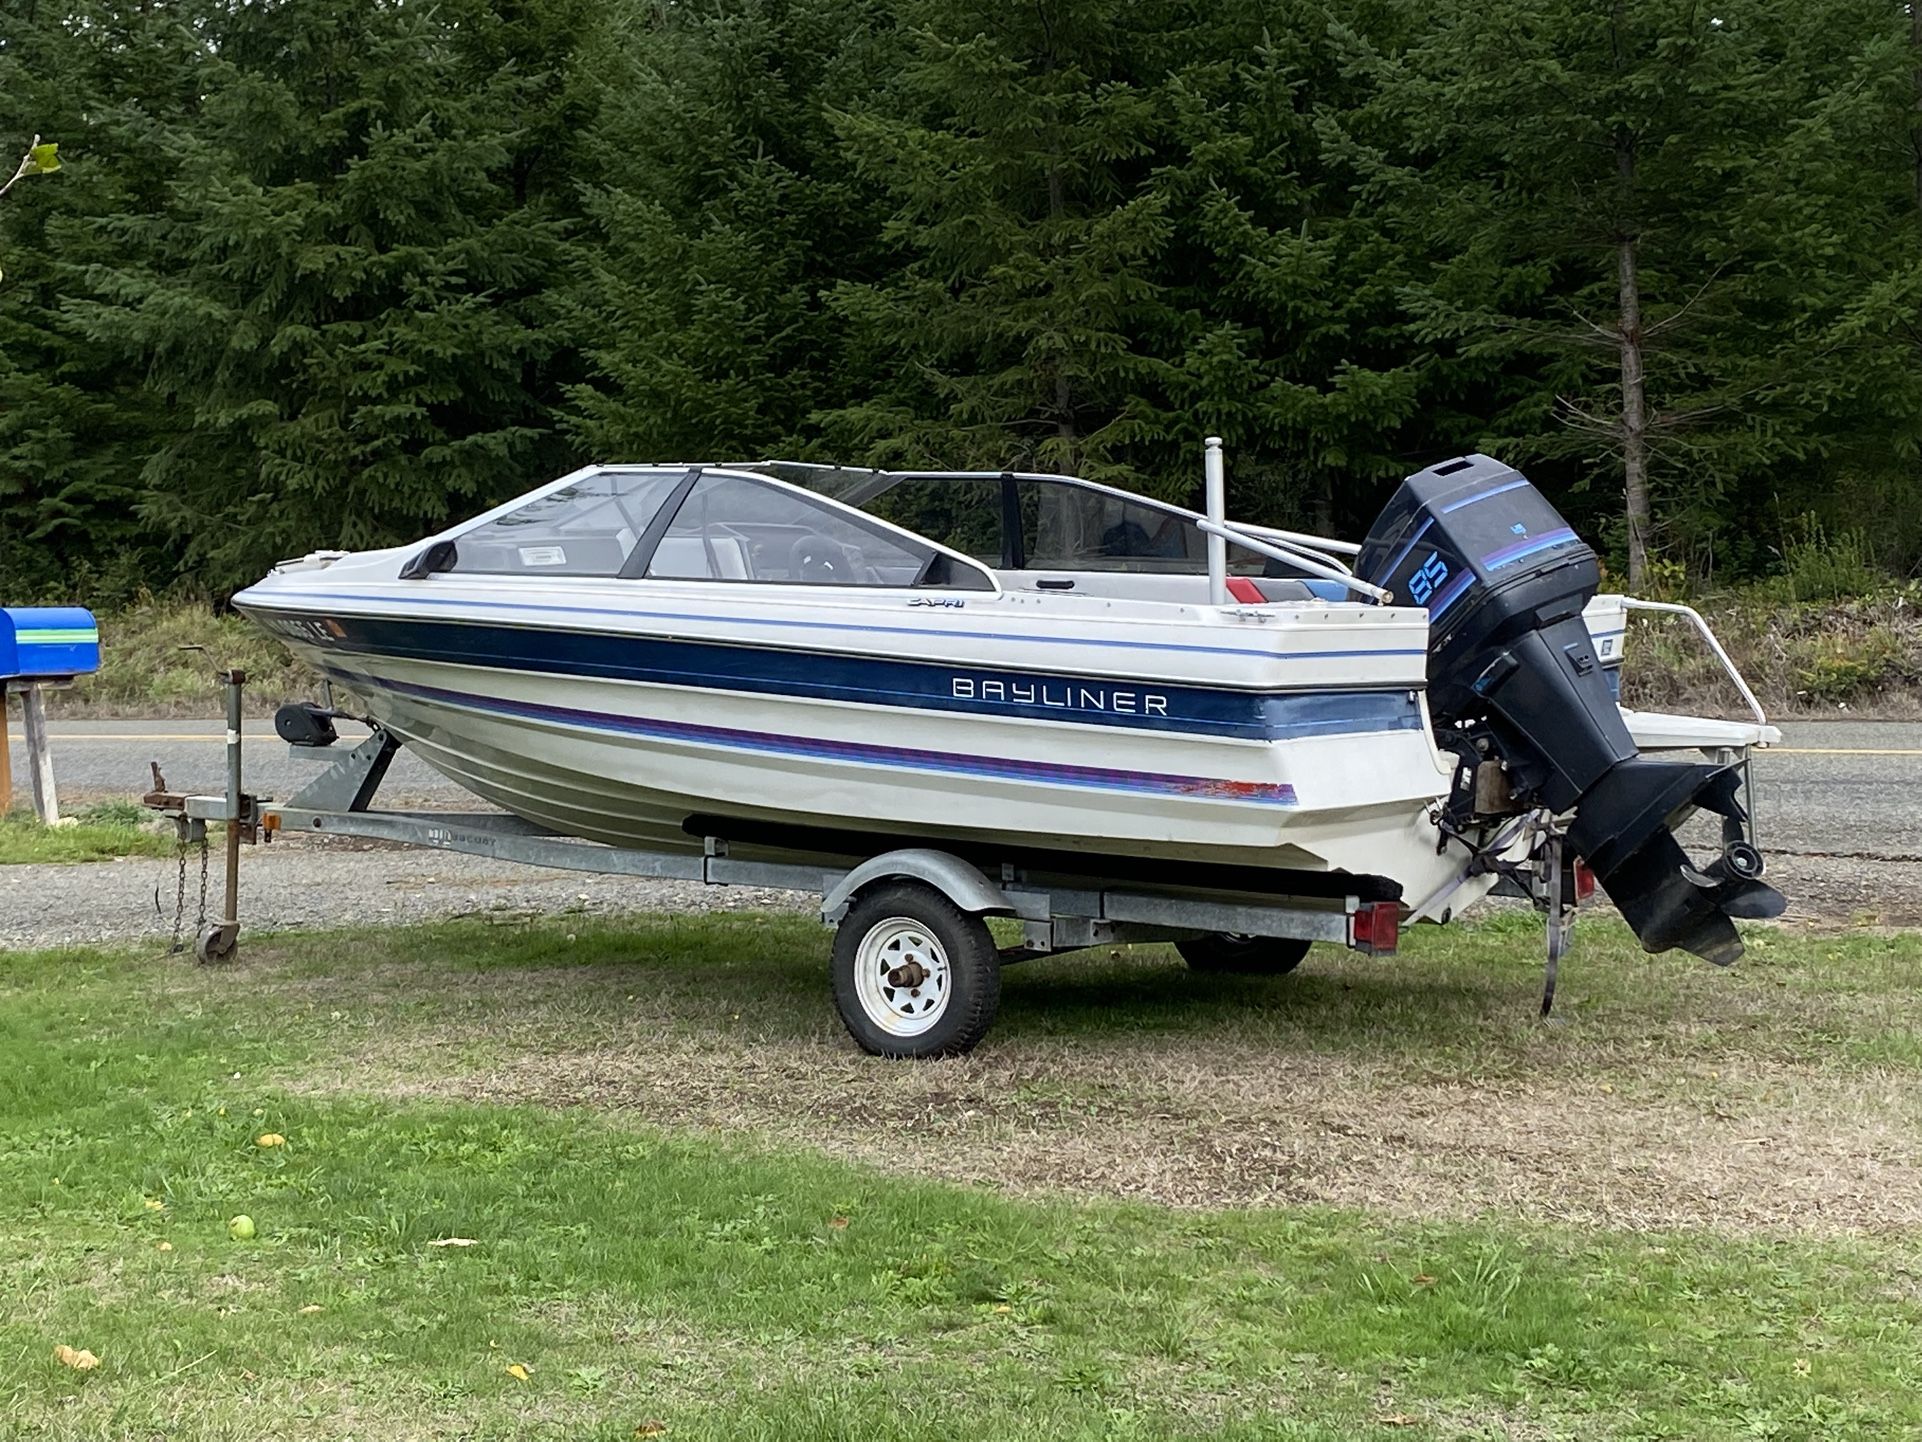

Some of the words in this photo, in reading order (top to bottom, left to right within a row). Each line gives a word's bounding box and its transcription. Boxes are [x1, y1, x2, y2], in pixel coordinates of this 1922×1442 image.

[1408, 551, 1448, 605] 85
[907, 597, 966, 608] CAPRI
[952, 678, 1167, 716] BAYLINER
